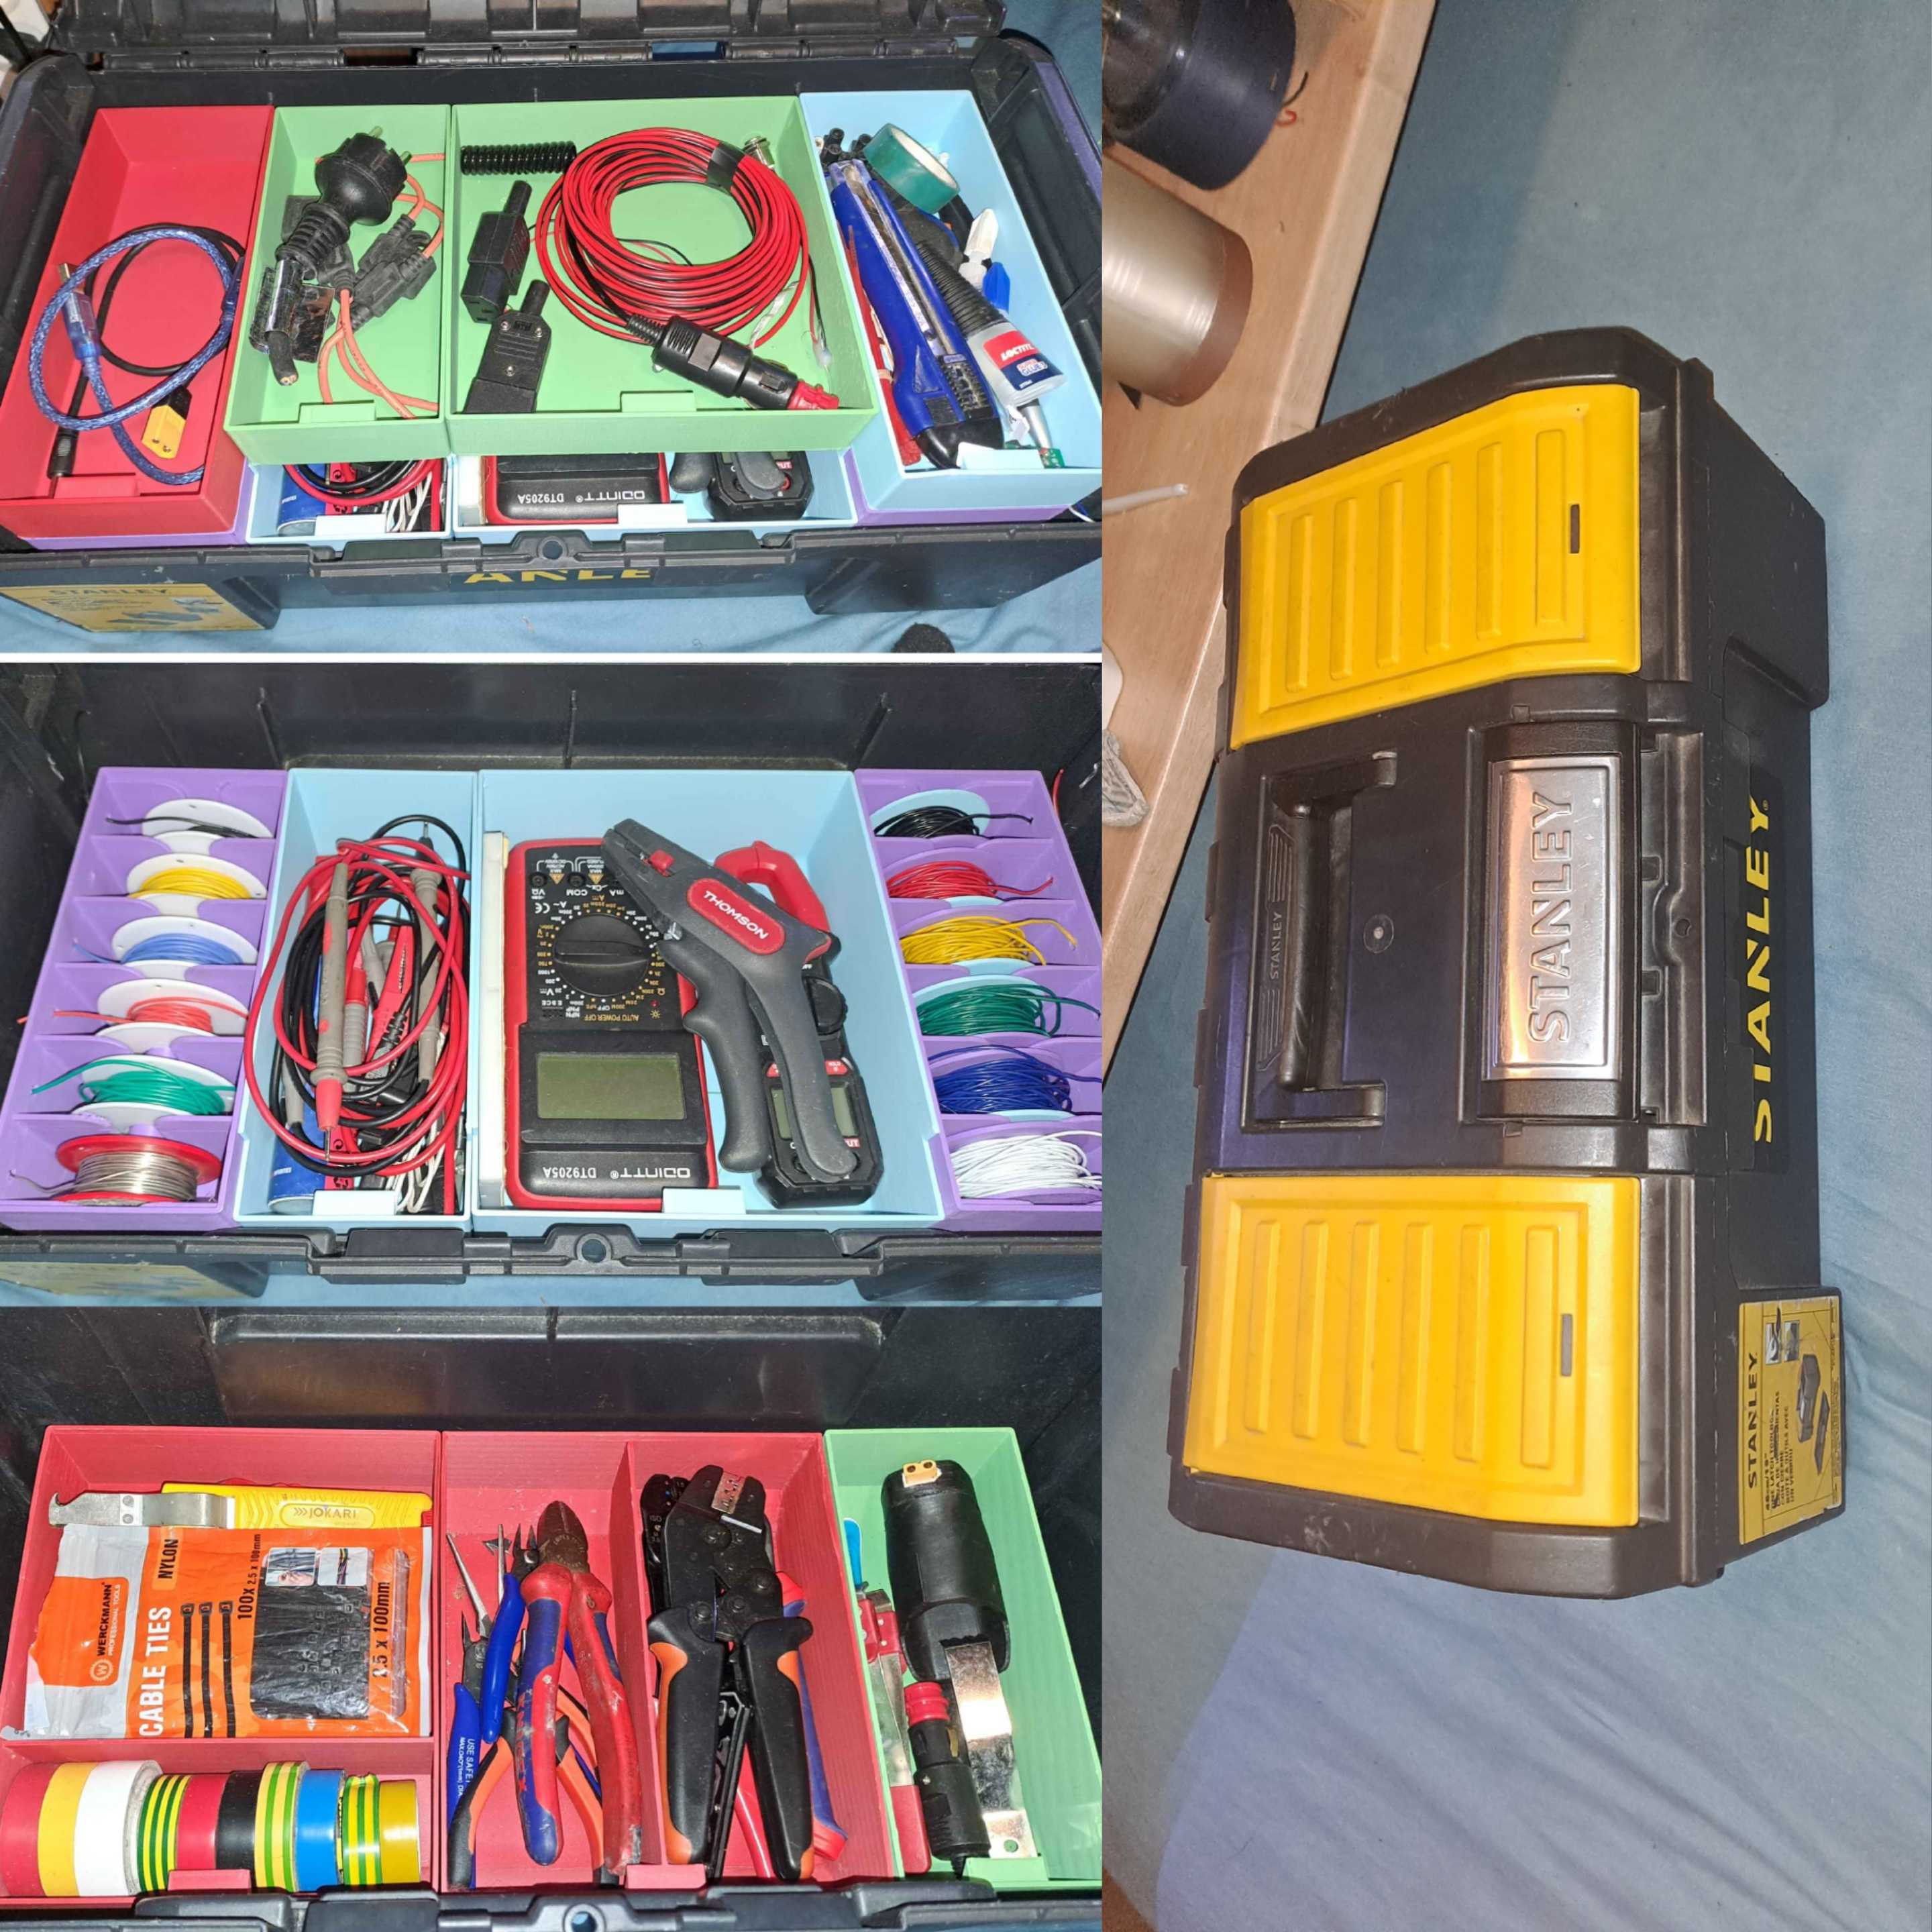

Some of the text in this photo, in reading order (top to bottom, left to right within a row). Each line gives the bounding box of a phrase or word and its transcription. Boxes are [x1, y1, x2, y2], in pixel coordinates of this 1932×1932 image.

[517, 493, 564, 504] DT9205A
[703, 890, 769, 940] THOMSON
[1527, 791, 1572, 1043] STANLEY
[1269, 912, 1283, 980] STANLEY
[542, 1167, 597, 1179] DT9205A
[1748, 1352, 1758, 1489] STANLEY
[309, 1507, 356, 1519] JOKARI
[158, 1538, 178, 1579] NYLON
[97, 1585, 112, 1658] WERCKMANN
[108, 1584, 121, 1656] PROFESSIONAL TOOLS
[374, 1582, 390, 1632] 100mm
[138, 1607, 172, 1737] CABLE TIES
[466, 1738, 475, 1756] USE
